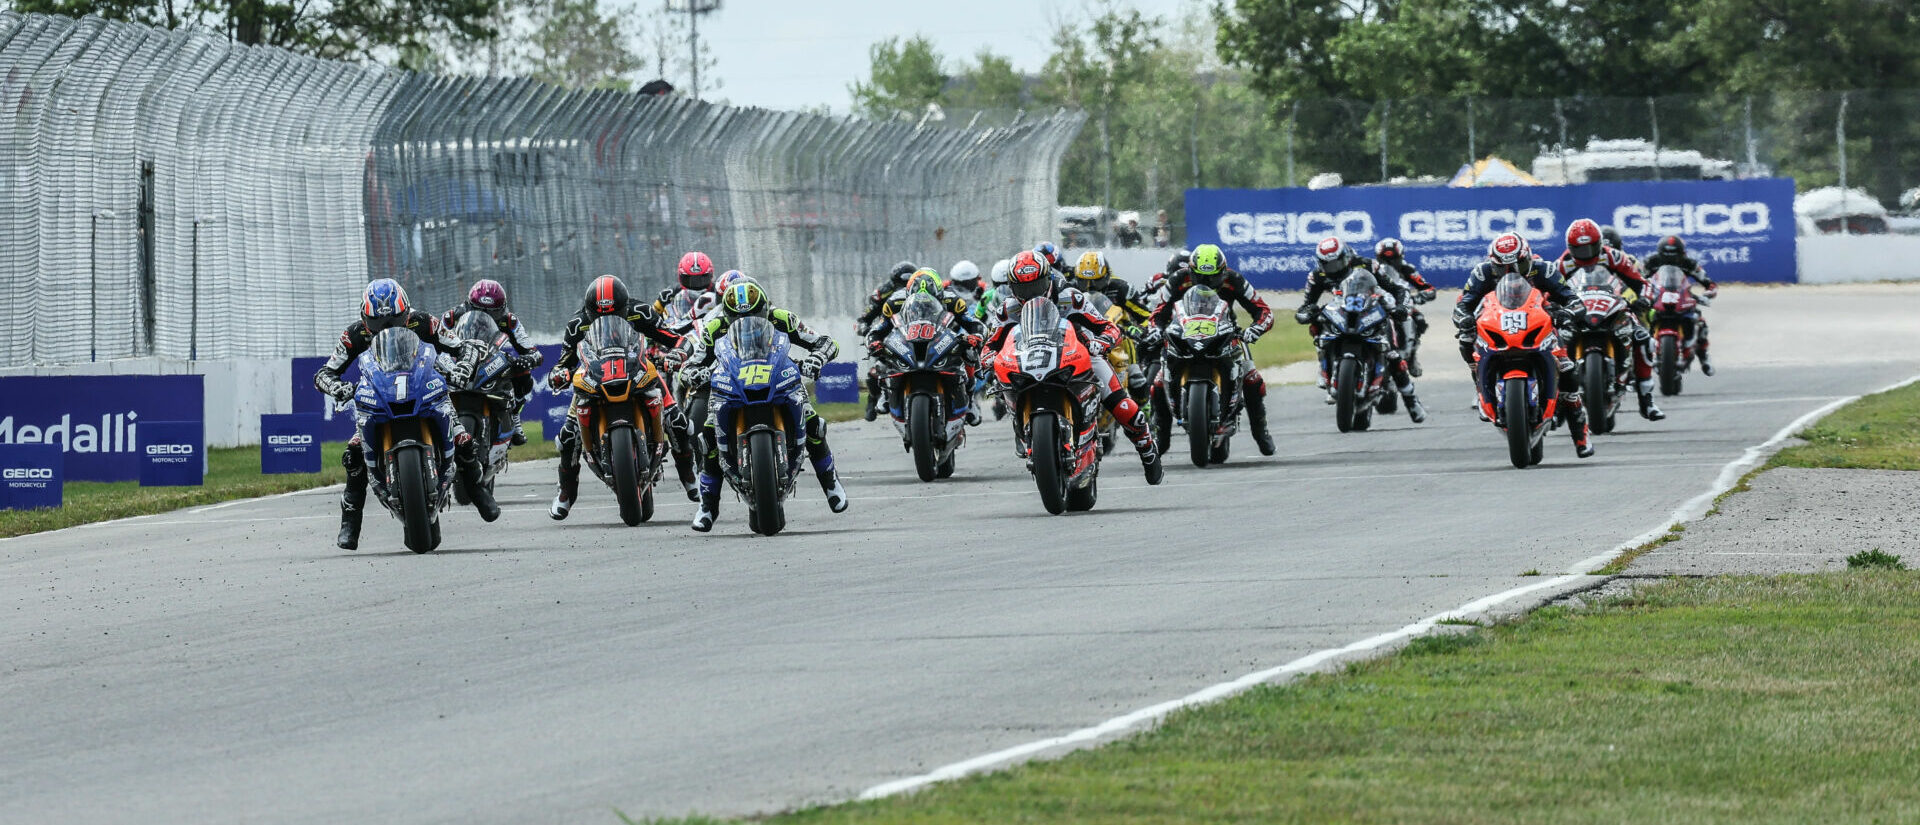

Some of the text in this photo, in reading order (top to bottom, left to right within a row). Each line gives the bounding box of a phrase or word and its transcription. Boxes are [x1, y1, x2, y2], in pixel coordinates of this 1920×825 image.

[1216, 210, 1374, 245] GEICO
[1400, 208, 1555, 242] GEICO
[1613, 202, 1770, 237] GEICO
[1345, 296, 1365, 311] 23
[1183, 321, 1216, 337] 25
[1500, 312, 1528, 331] 69
[906, 324, 935, 340] 80
[601, 358, 627, 382] 11
[738, 364, 773, 386] 45
[394, 375, 408, 401] 1
[267, 434, 313, 445] GEICO
[146, 444, 193, 455] GEICO
[2, 468, 53, 479] GEICO
